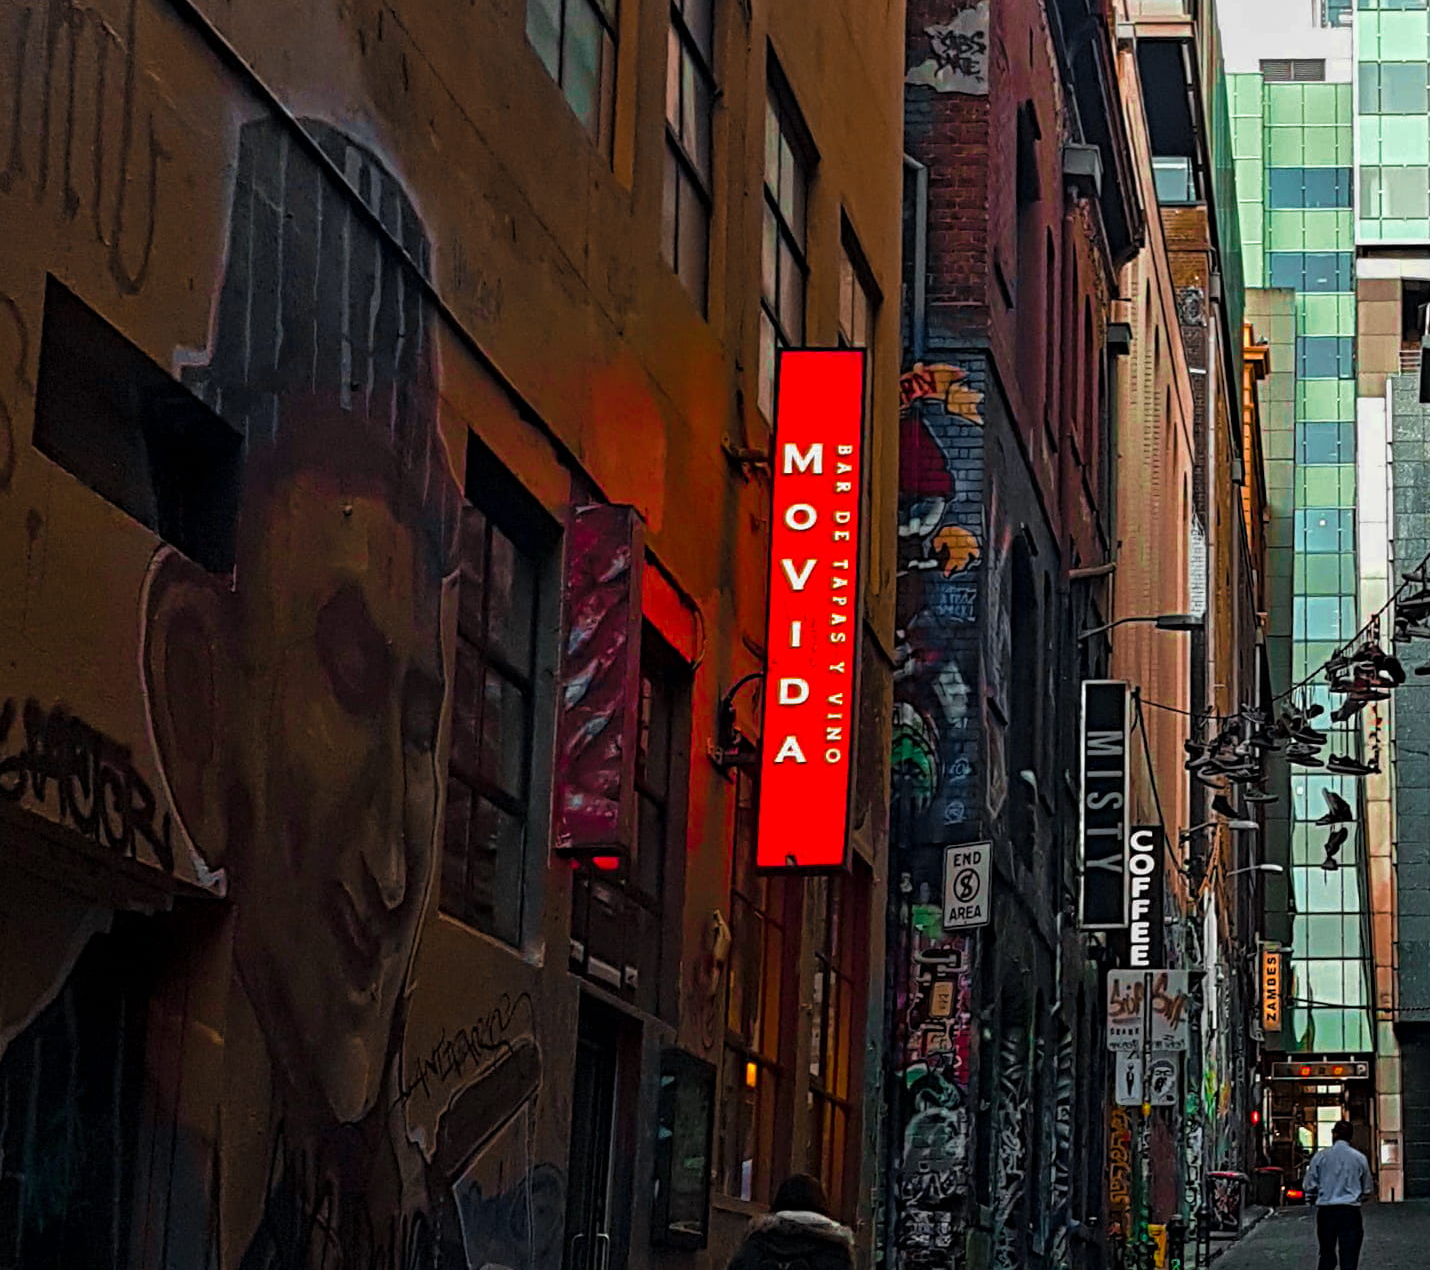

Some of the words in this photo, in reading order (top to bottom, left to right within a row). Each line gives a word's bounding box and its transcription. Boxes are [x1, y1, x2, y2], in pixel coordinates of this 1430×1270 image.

[835, 444, 853, 493] BAR
[831, 510, 851, 542] DE
[774, 442, 824, 763] MOVIDA
[830, 559, 849, 644] TAPAS
[828, 661, 845, 674] Y
[824, 692, 843, 764] VINO
[1086, 730, 1124, 874] MISTY
[953, 851, 982, 867] END
[949, 905, 982, 921] AREA
[1129, 830, 1155, 967] COFFEE
